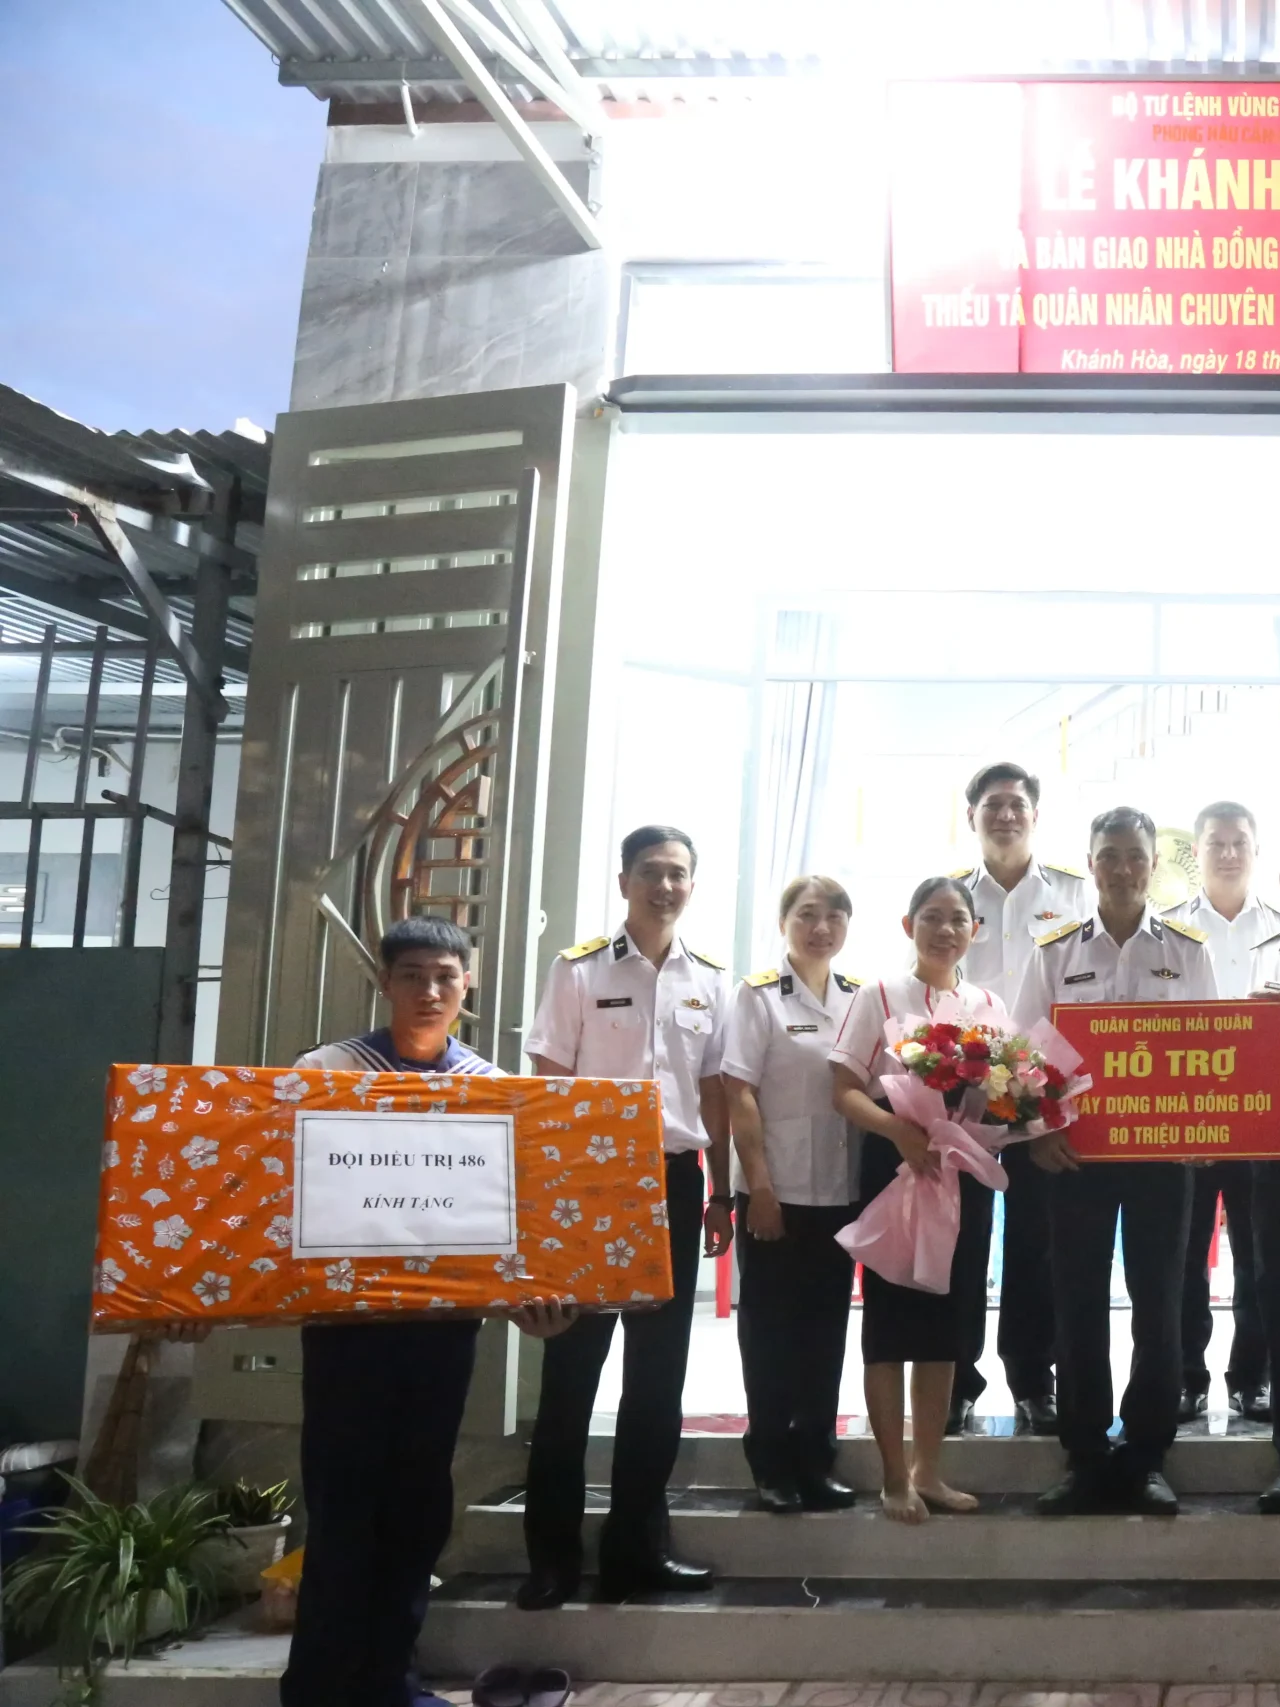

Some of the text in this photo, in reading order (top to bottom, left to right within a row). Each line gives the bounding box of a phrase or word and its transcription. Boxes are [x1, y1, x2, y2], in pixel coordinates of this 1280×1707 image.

[1143, 94, 1169, 116] TƯ
[1172, 92, 1221, 121] LỆNH
[1228, 92, 1279, 117] VÙNG
[1093, 236, 1148, 269] GIAO
[1156, 230, 1206, 269] NHÀ
[1212, 226, 1278, 270] ĐỒNG
[996, 286, 1025, 326] TÁ
[1033, 287, 1098, 329] QUÂN
[1106, 287, 1173, 326] NHÂN
[1180, 287, 1274, 326] CHUYÊN
[1061, 349, 1124, 370] Khánh
[1131, 349, 1174, 372] Hòa,
[1180, 349, 1228, 374] ngày
[1235, 350, 1256, 370] 18
[1090, 1012, 1253, 1035] QUÂN CHỦNG HẢI QUÂN
[1104, 1040, 1237, 1082] HỖ TRỢ
[1106, 1094, 1150, 1118] DỰNG
[1155, 1091, 1189, 1113] NHÀ
[1193, 1089, 1239, 1113] ĐỒNG
[1244, 1090, 1271, 1116] ĐỘI
[1109, 1119, 1230, 1149] 80 TRIỆU ĐỒNG
[328, 1151, 363, 1170] ĐỘI
[421, 1153, 452, 1170] TRỊ
[458, 1154, 486, 1168] 486
[362, 1193, 405, 1209] KÍNH
